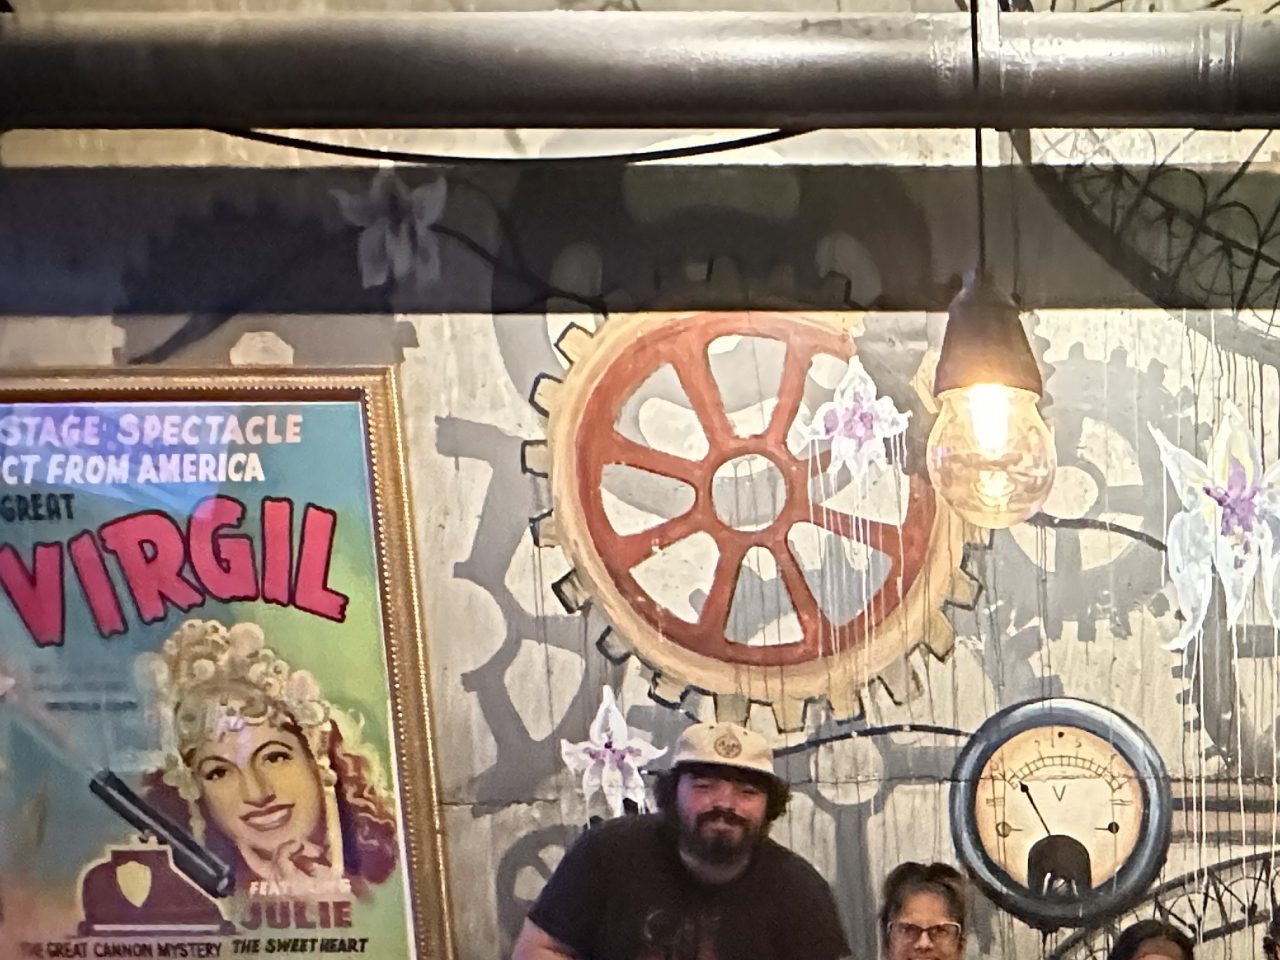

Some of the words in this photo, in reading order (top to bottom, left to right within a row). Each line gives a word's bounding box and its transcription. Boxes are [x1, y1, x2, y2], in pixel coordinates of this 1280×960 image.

[0, 414, 100, 448] STAGE
[117, 413, 302, 446] SPECTACLE
[0, 454, 41, 485] CT
[46, 454, 130, 485] FROM
[137, 453, 265, 483] AMERICA
[0, 493, 75, 522] GREAT
[0, 495, 349, 648] VIRGIL
[239, 900, 354, 930] JULIE
[46, 941, 88, 959] GREAT
[93, 941, 154, 959] CANNON
[157, 941, 222, 959] MYSTERY
[231, 938, 260, 953] THE
